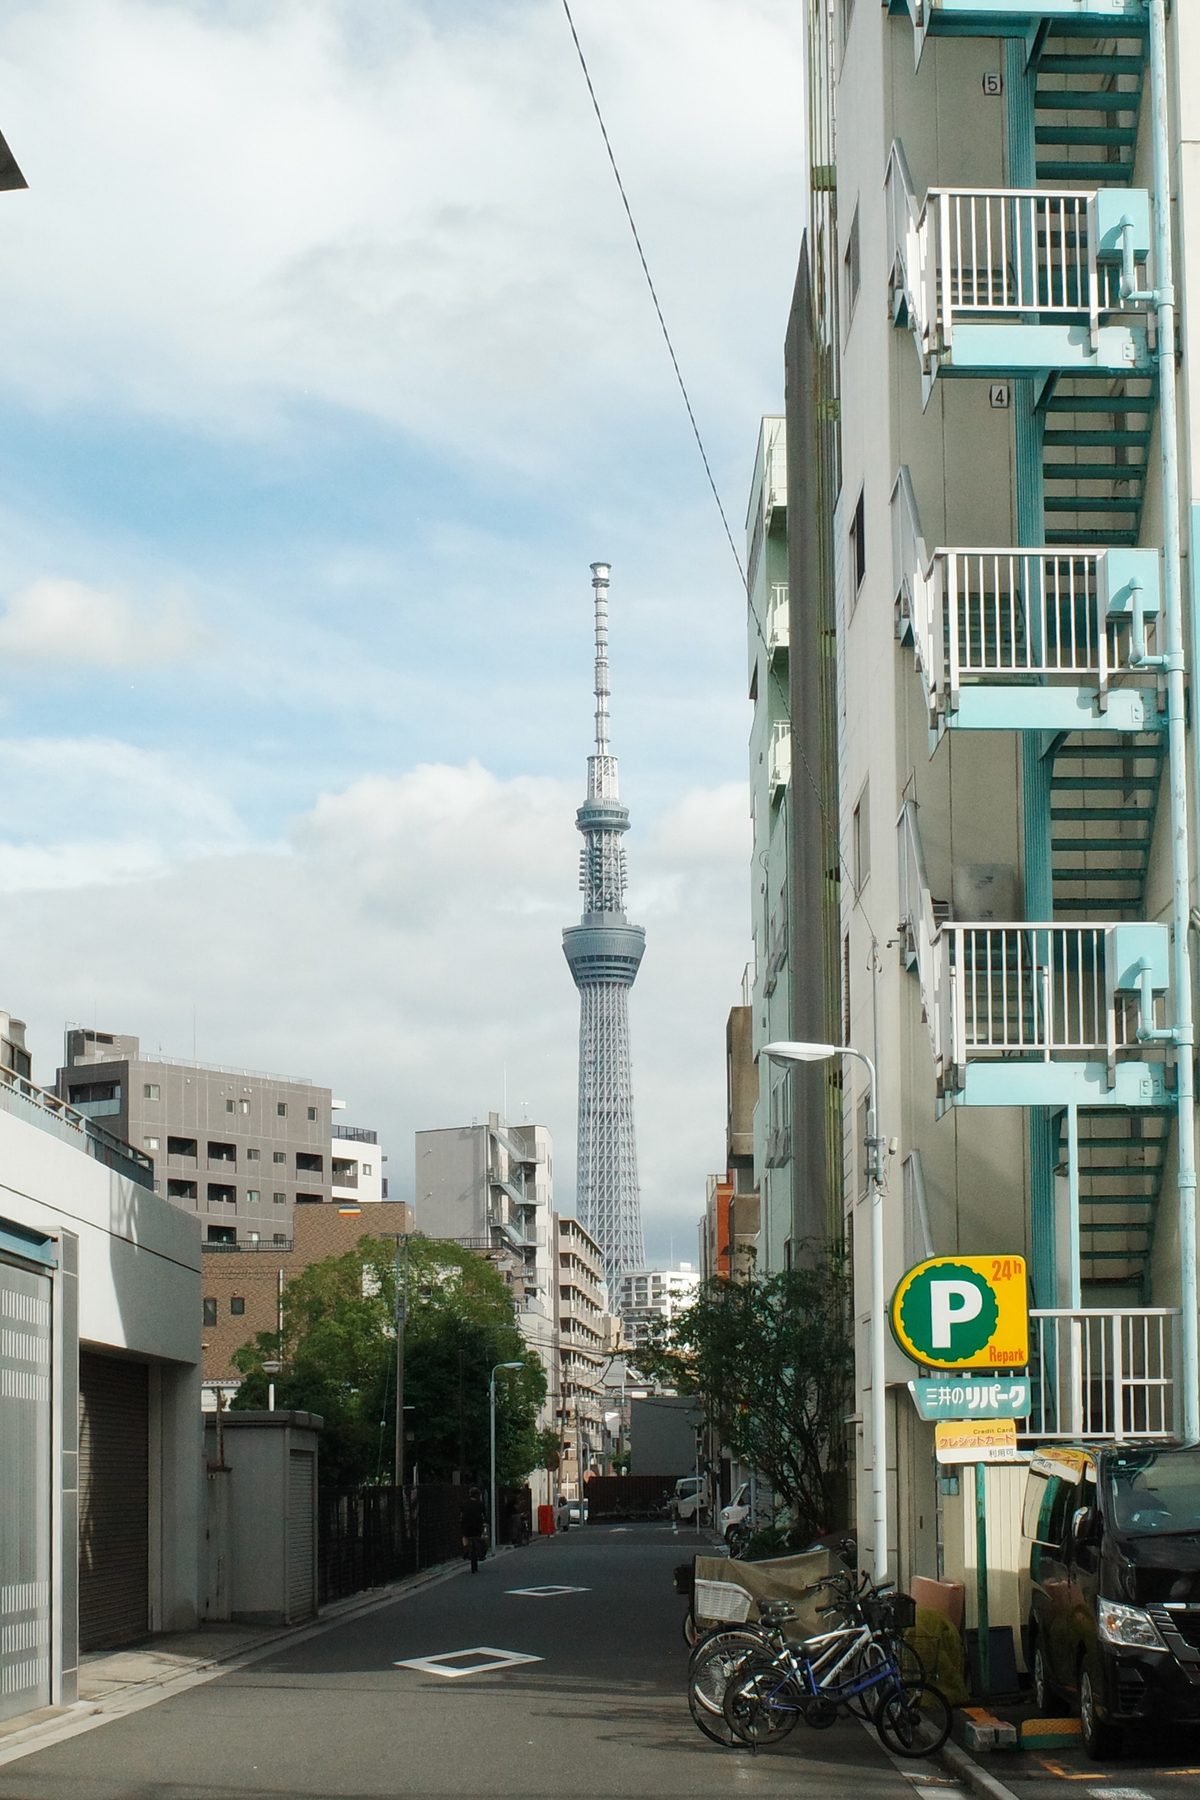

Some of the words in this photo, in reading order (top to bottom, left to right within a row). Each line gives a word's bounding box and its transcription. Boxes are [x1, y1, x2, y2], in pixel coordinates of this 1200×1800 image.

[988, 76, 998, 91] 5
[995, 389, 1005, 405] 4
[992, 1260, 1022, 1281] 24h
[930, 1280, 983, 1349] P
[989, 1346, 1024, 1363] Repark
[926, 1384, 1025, 1409] 三井のリパーク
[940, 1434, 1013, 1448] クレジットカード
[989, 1448, 1013, 1458] 利用可
